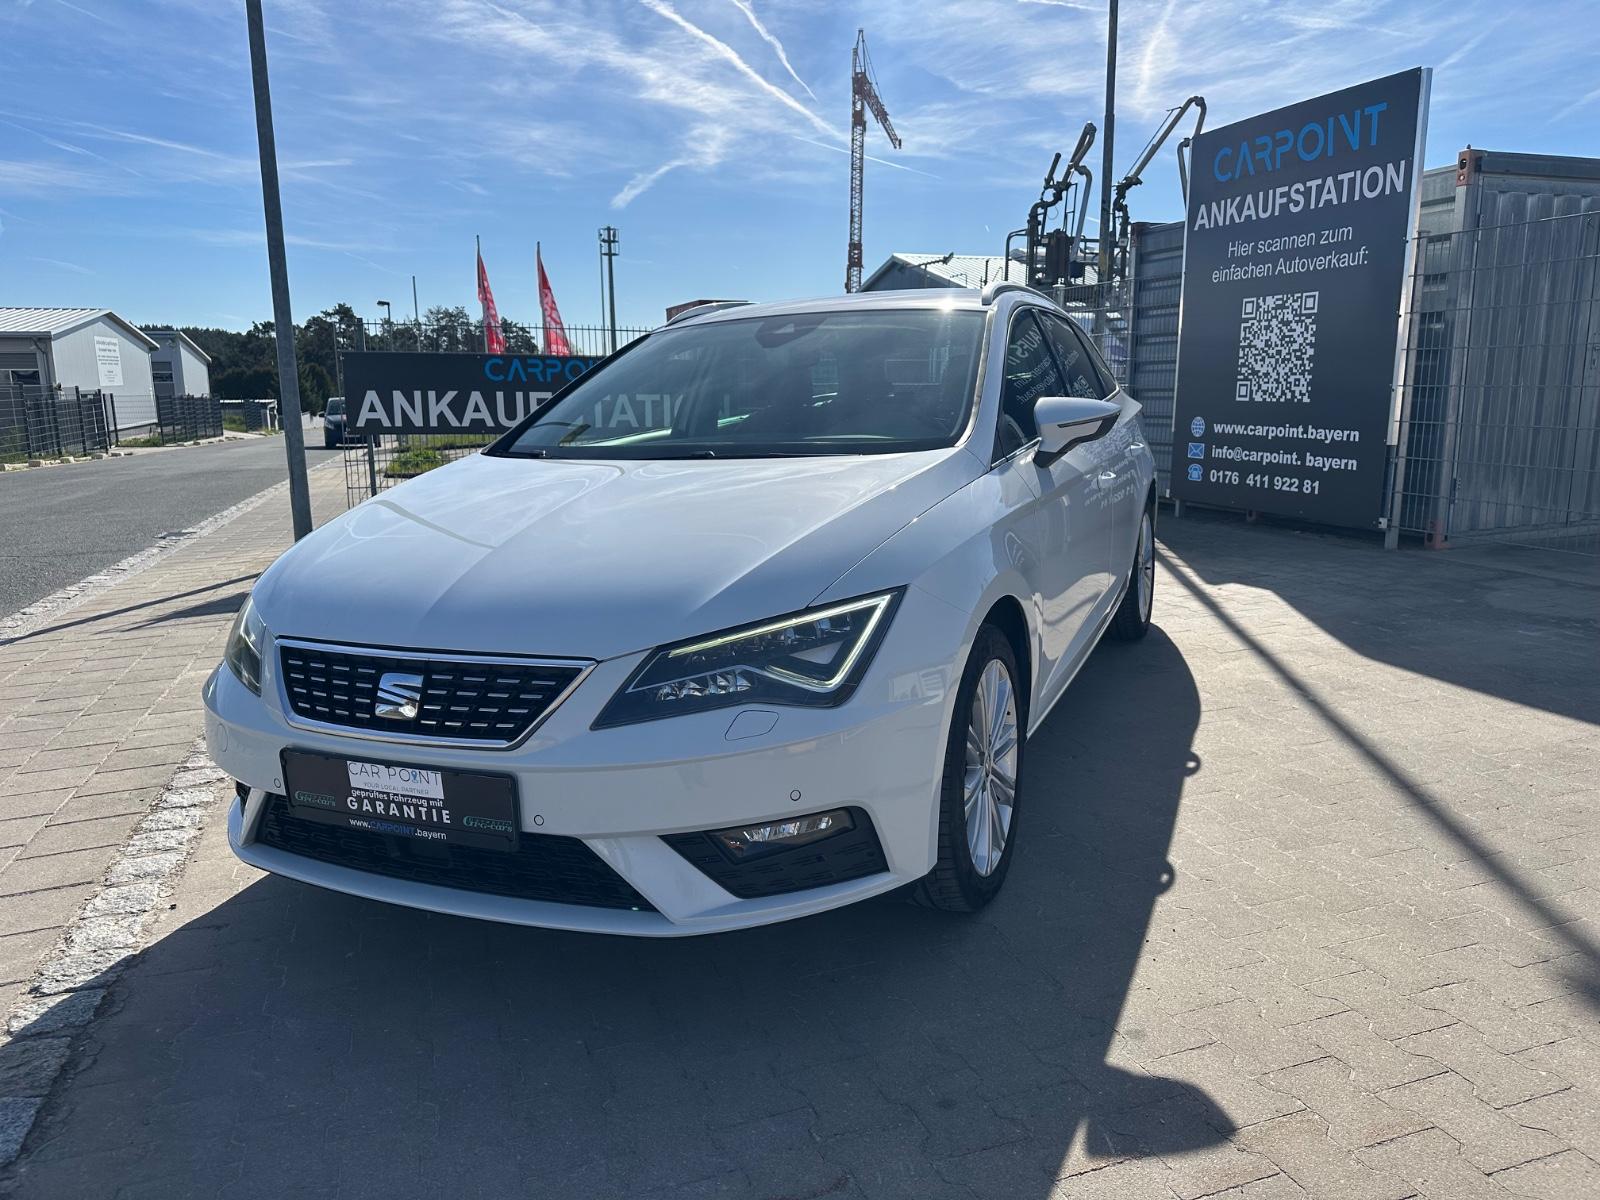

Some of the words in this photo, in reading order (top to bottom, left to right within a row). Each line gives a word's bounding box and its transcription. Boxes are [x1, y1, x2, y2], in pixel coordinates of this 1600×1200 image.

[1214, 102, 1388, 182] CARPOINT
[1194, 160, 1405, 231] ANKAUFSTATION
[1228, 240, 1254, 258] Hier
[1257, 232, 1315, 254] scannen
[1320, 226, 1353, 245] zum
[1212, 262, 1272, 283] einfachen
[1275, 246, 1369, 275] Autoverkauf:
[1213, 423, 1360, 444] www.carpoint.bayern
[1211, 445, 1301, 465] info@carpoint.
[1305, 452, 1358, 471] bayern
[1210, 469, 1239, 485] 0176
[1246, 473, 1269, 489] 411
[1273, 476, 1299, 492] 922
[1303, 479, 1320, 495] 81
[348, 762, 380, 778] CAR
[389, 793, 428, 807] Fahrzeug
[429, 799, 443, 808] mit
[401, 786, 429, 795] PARTNER
[346, 796, 451, 824] GARANTIE
[349, 818, 447, 840] www.CARPOINT.bayern
